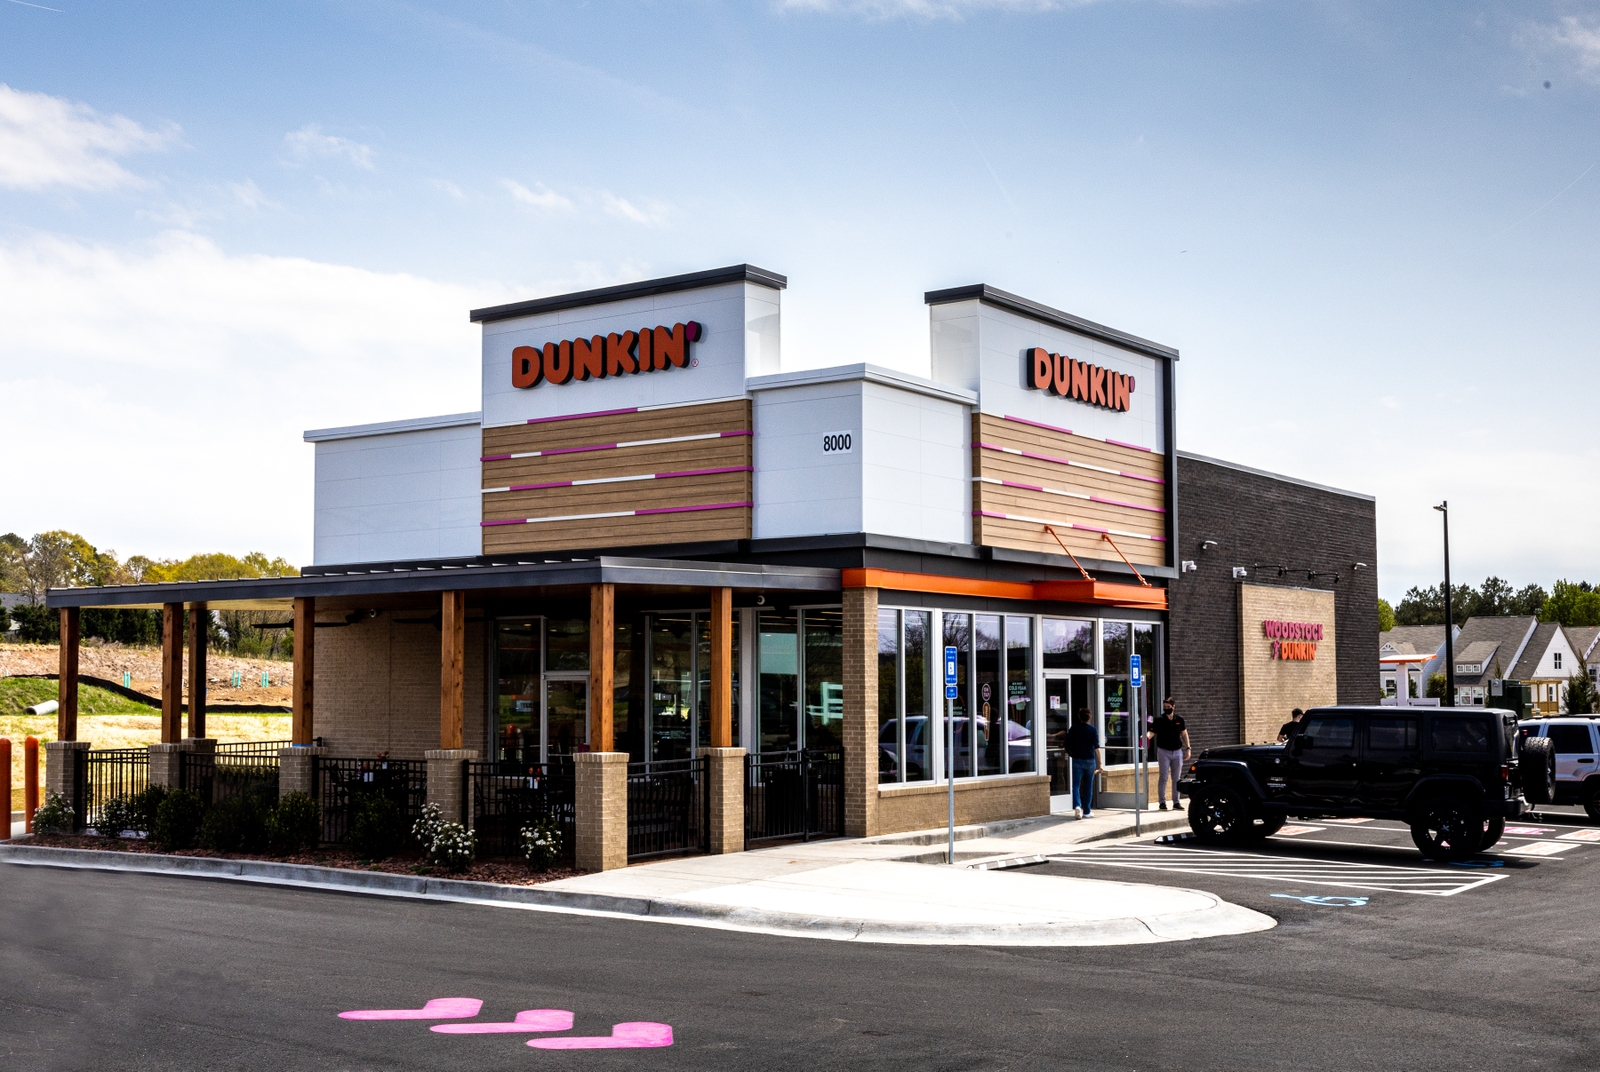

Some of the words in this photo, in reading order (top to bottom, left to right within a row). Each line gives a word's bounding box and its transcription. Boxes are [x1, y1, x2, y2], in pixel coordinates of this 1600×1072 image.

[512, 320, 702, 389] DUNKIN'
[1027, 347, 1135, 412] DUNKIN'
[823, 433, 852, 452] 8000
[1264, 620, 1323, 640] WOODSTOCK
[1281, 642, 1316, 660] DUNKIN'
